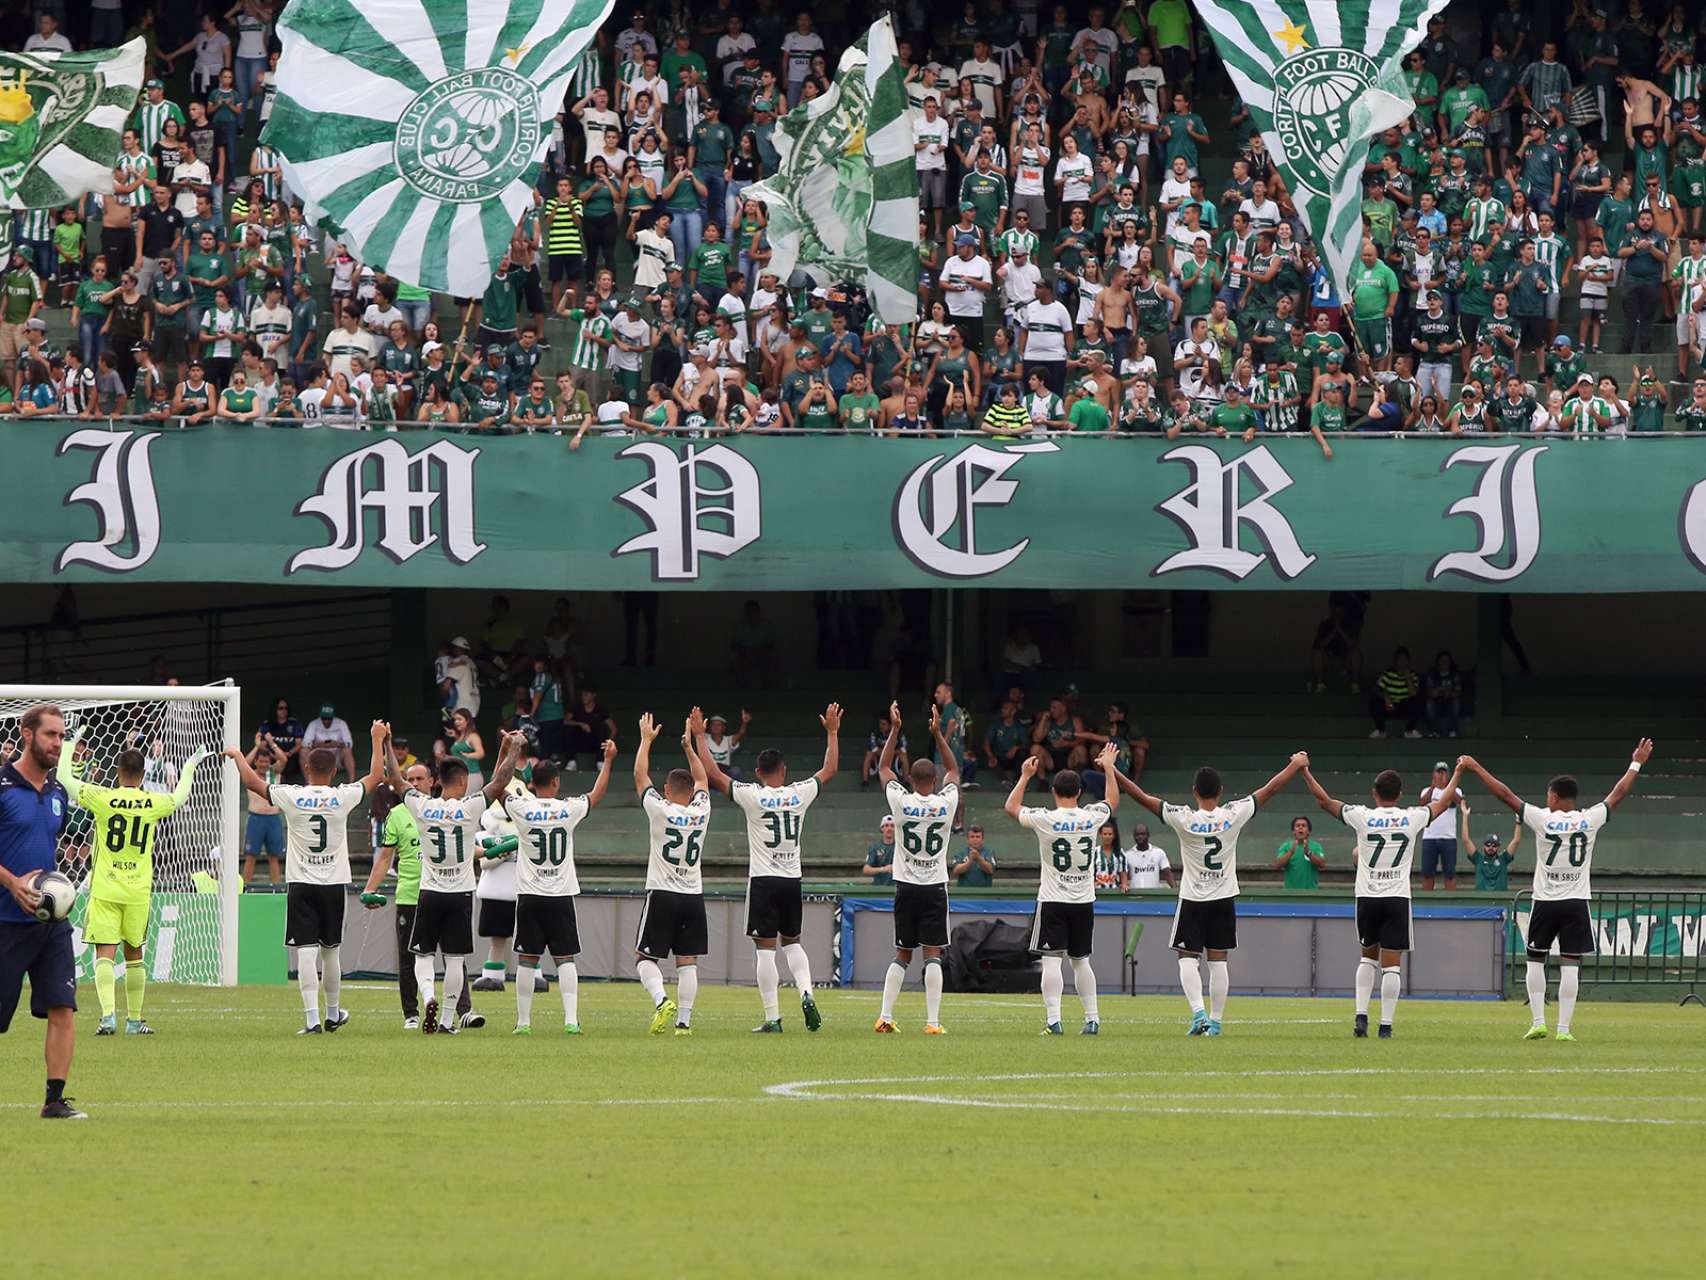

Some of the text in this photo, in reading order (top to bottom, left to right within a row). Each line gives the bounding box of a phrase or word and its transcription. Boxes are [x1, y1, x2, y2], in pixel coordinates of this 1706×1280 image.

[1283, 54, 1329, 85] FOOT
[1337, 53, 1372, 82] BALL
[55, 428, 1706, 581] IMPÉRI
[110, 798, 153, 809] CAIXA
[296, 797, 340, 808] CAIXA
[760, 794, 800, 808] CAIXA
[903, 806, 947, 817] CAIXA
[423, 809, 465, 819] CAIXA
[525, 809, 569, 821] CAIXA
[667, 815, 706, 827] CAIXA
[1367, 817, 1409, 827] CAIXA
[1546, 820, 1590, 831] CAIXA
[106, 814, 150, 855] 84
[308, 814, 327, 853] 3
[761, 811, 800, 848] 34
[1052, 820, 1094, 832] CAIXA
[1190, 820, 1232, 832] CAIXA
[427, 825, 464, 864] 31
[528, 827, 567, 865] 30
[662, 828, 703, 867] 26
[902, 821, 945, 856] 66
[1545, 832, 1588, 867] 70
[1052, 837, 1093, 873] 83
[1204, 836, 1223, 870] 2
[1367, 833, 1409, 868] 77
[112, 861, 137, 871] WILSON
[1134, 865, 1156, 875] bwin
